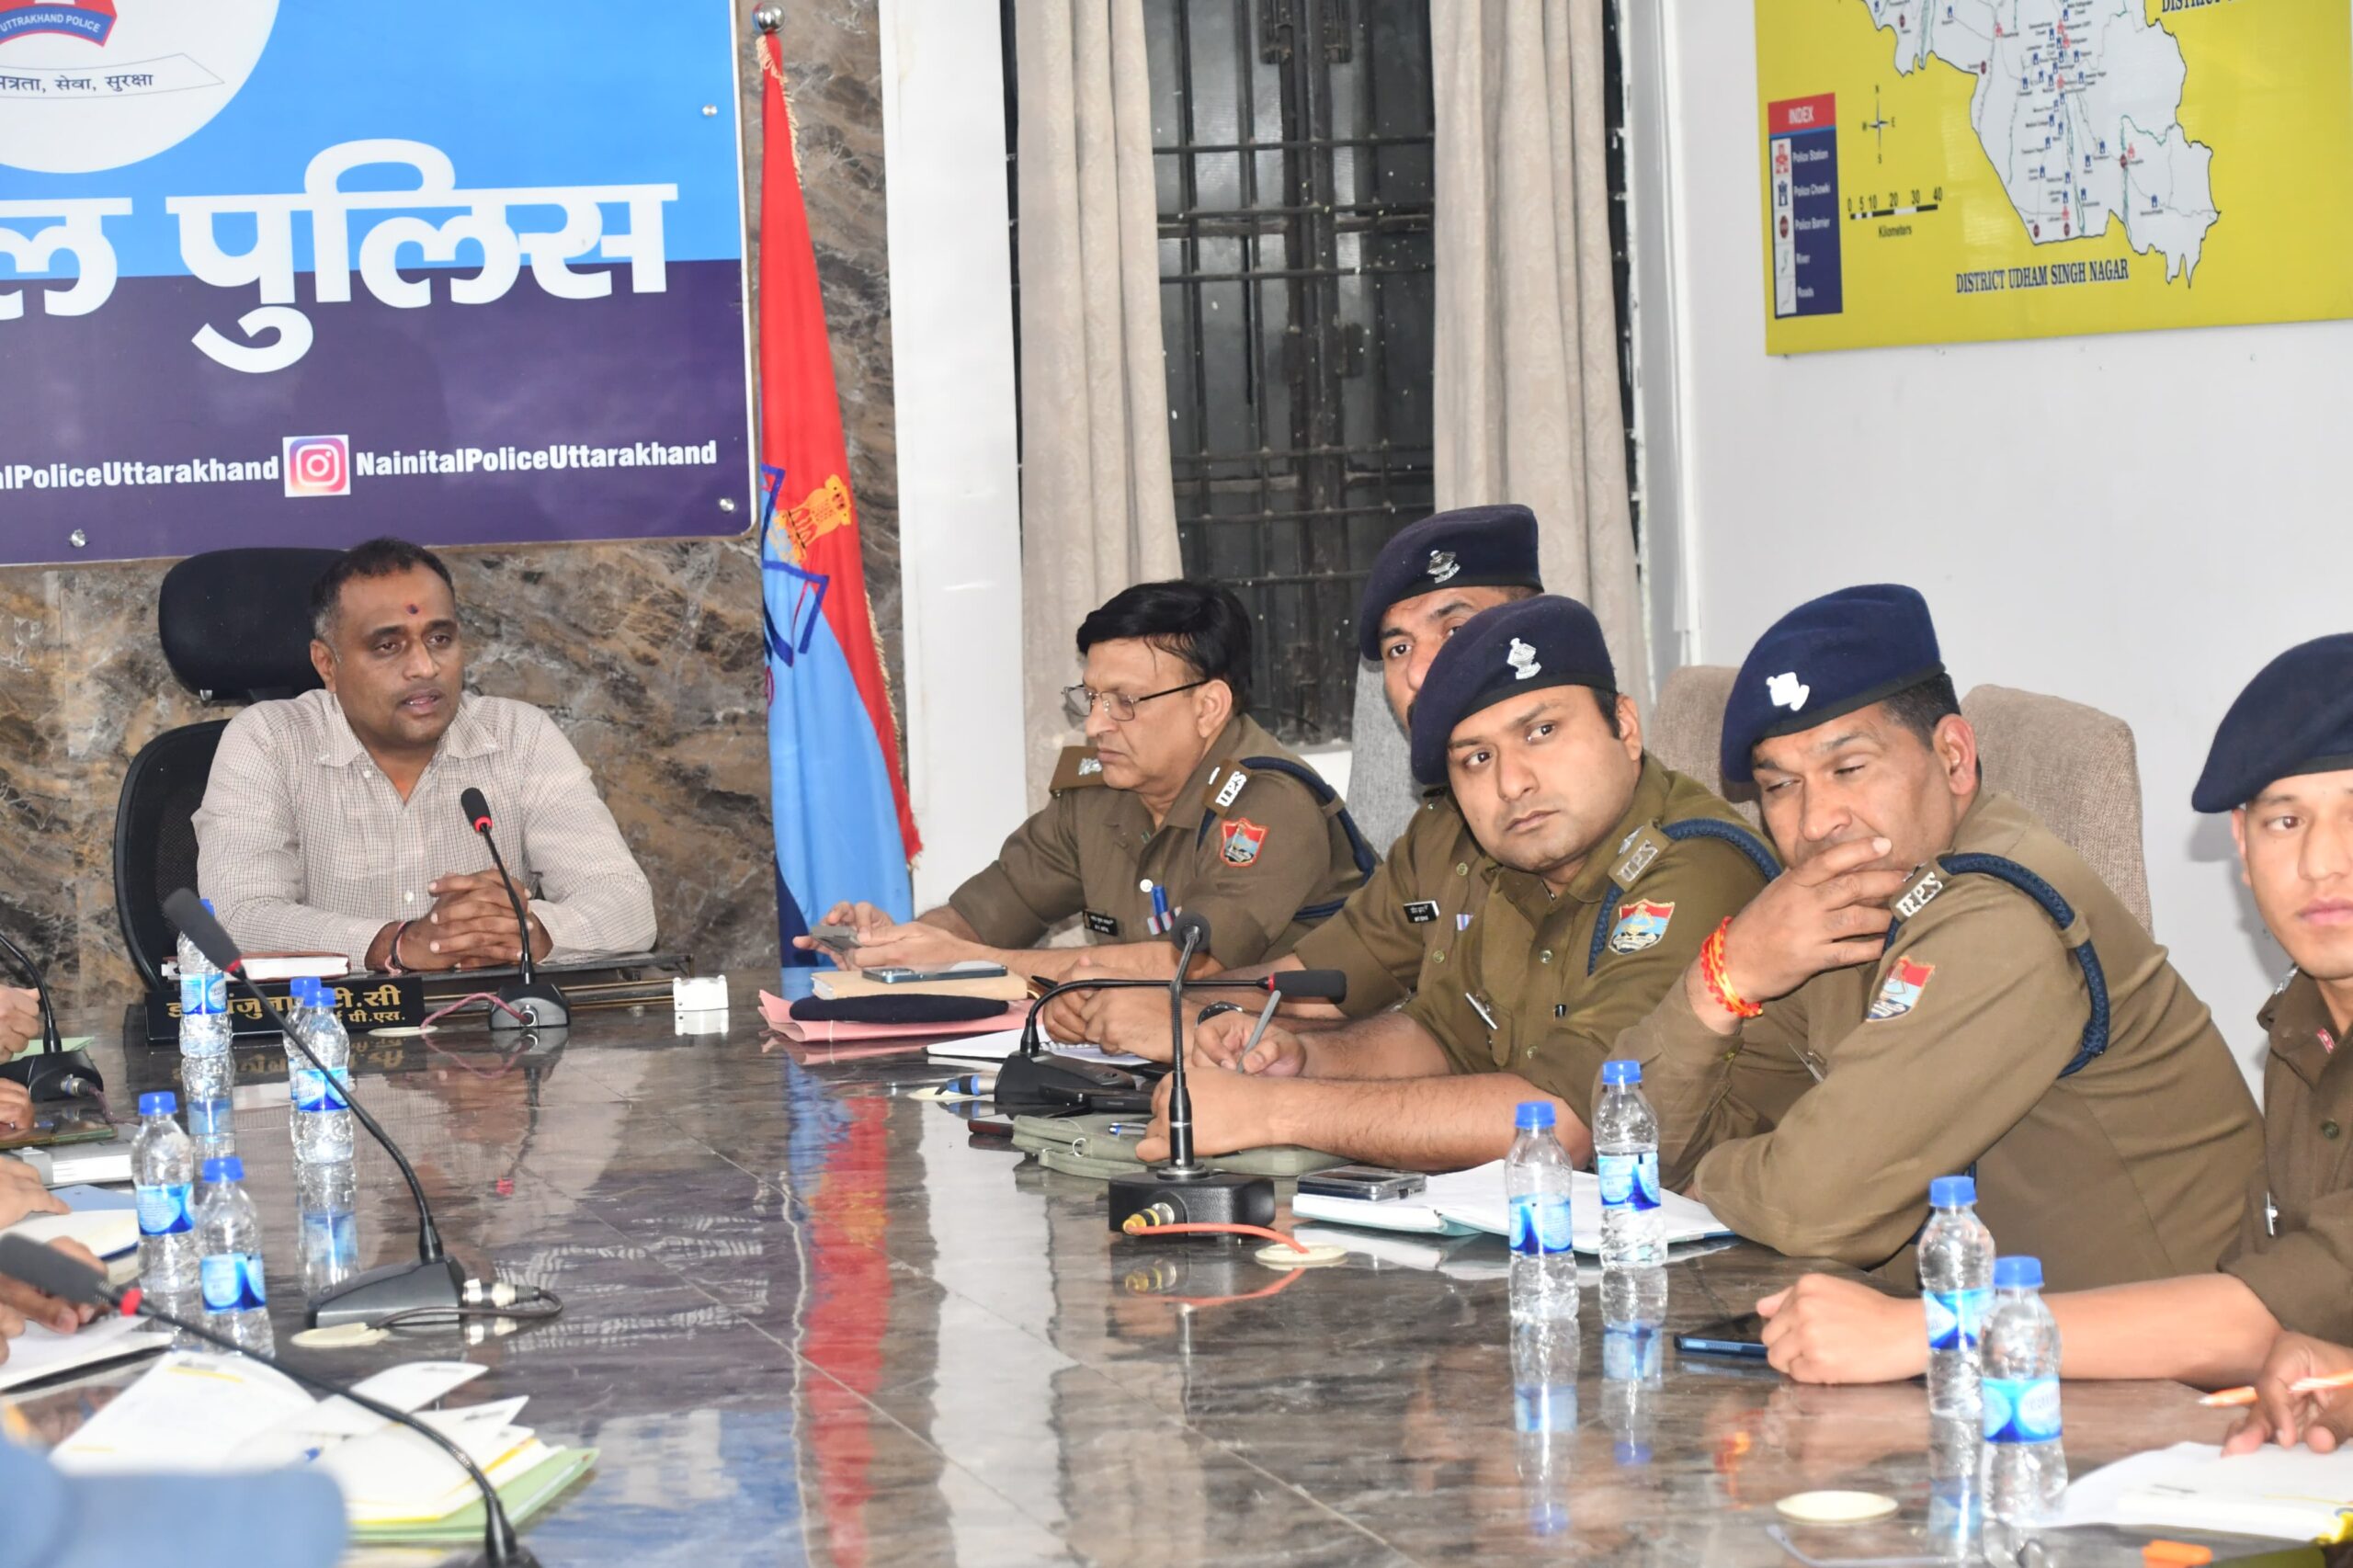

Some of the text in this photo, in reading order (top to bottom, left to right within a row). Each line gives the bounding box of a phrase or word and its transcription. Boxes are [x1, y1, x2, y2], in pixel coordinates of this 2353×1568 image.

[0, 14, 101, 33] UTTRAKHAND POLICE
[55, 74, 97, 92] सेवा,
[105, 74, 153, 92] सुरक्षा
[1789, 105, 1814, 125] INDEX
[1869, 195, 1878, 210] 10
[1889, 192, 1899, 208] 20
[1911, 189, 1921, 205] 30
[1933, 187, 1943, 202] 40
[165, 138, 679, 373] पुलिस
[1956, 258, 2130, 293] DISTRICT UDHAM SINGH NAGAR
[356, 440, 717, 476] NainitalPoliceUttarakhand
